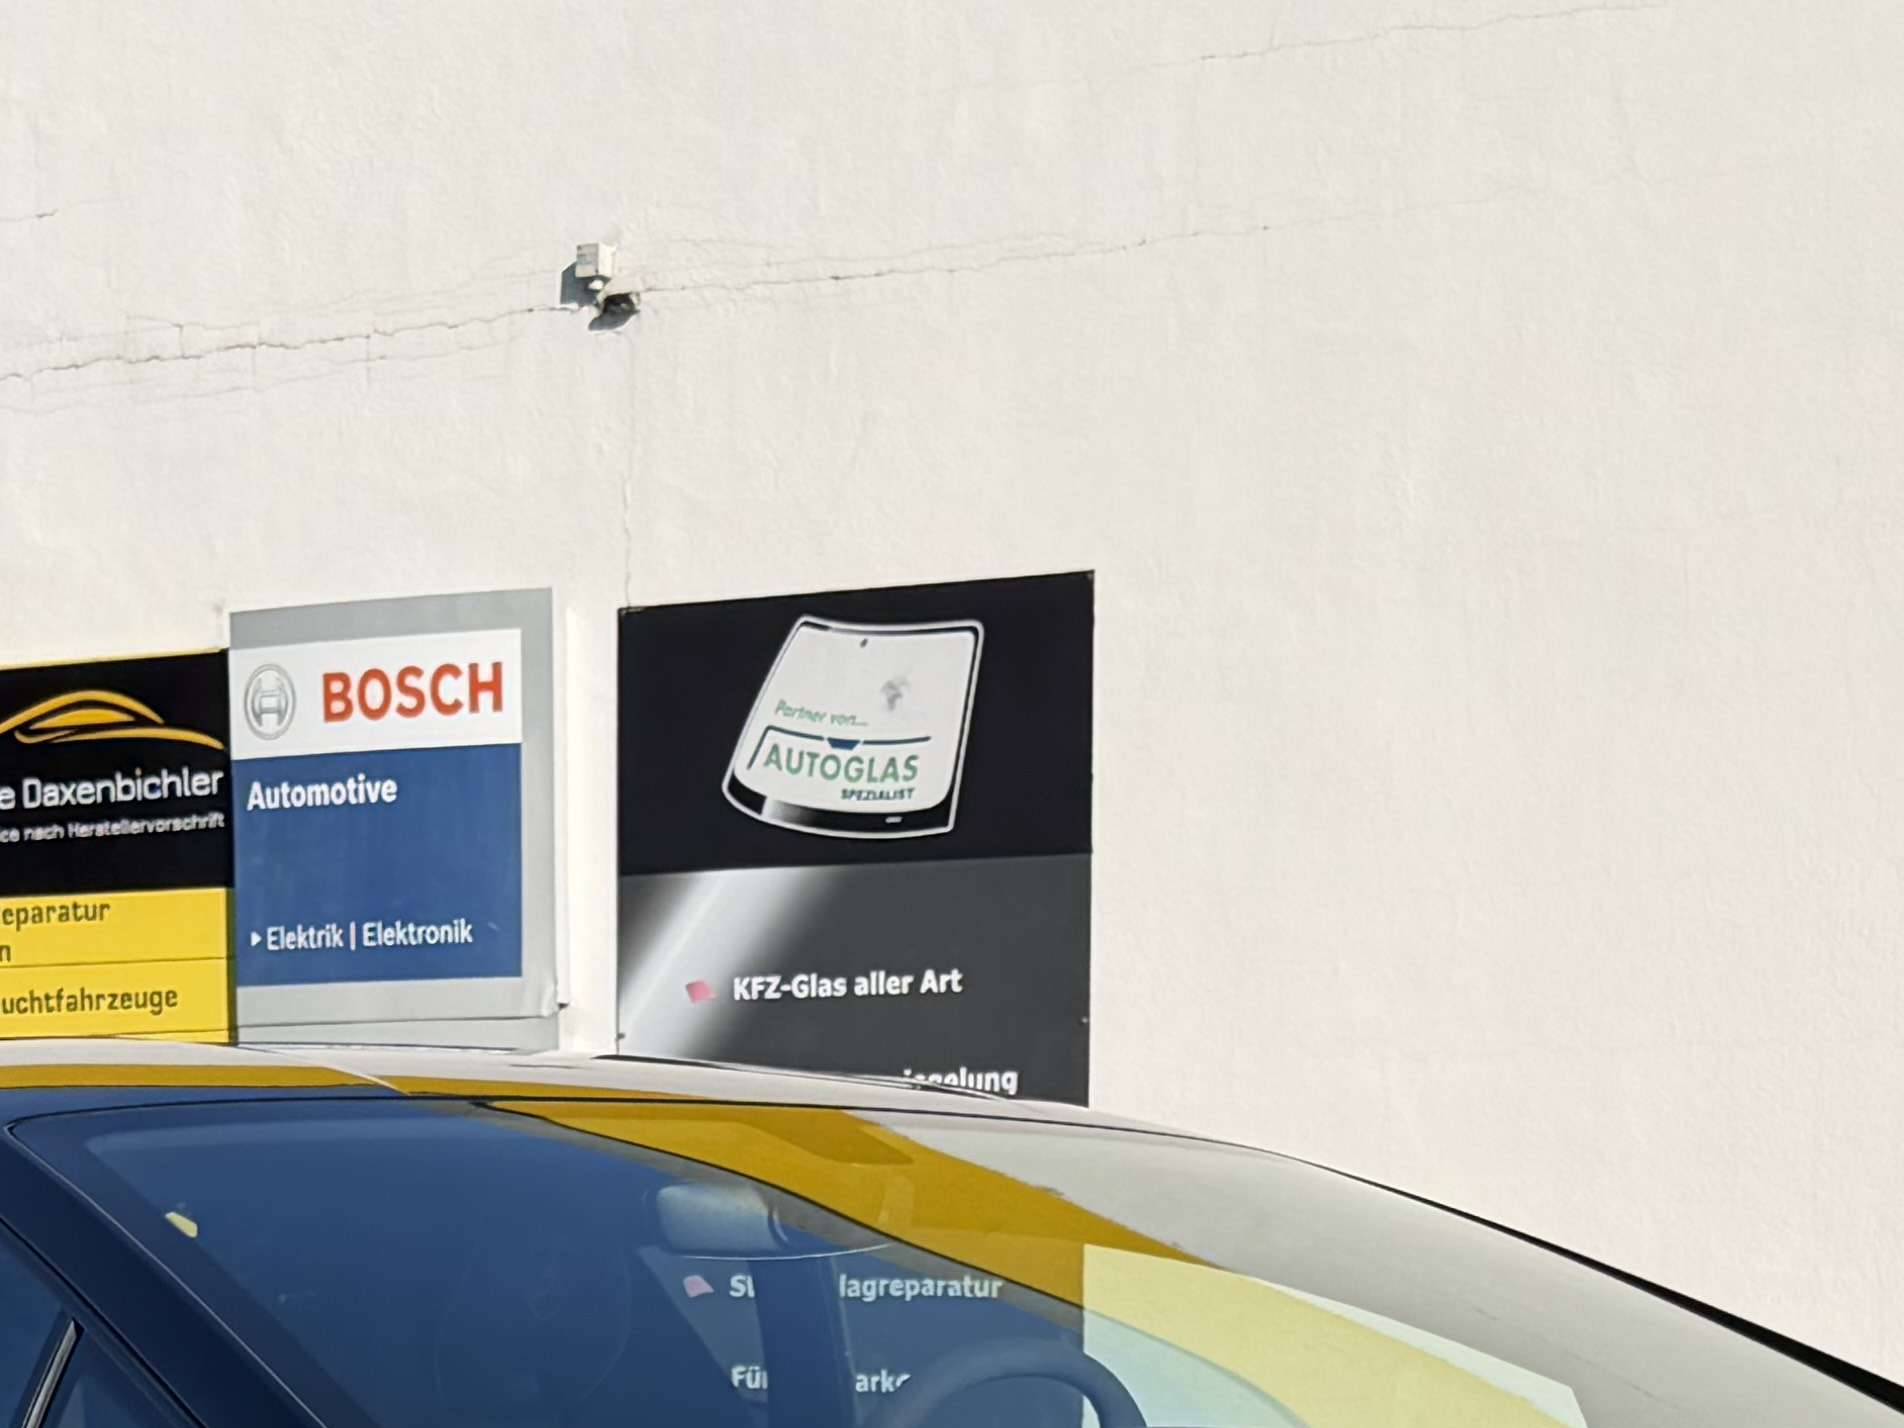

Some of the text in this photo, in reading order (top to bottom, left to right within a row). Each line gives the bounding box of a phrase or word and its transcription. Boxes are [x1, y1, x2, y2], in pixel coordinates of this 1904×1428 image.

[322, 662, 504, 723] BOSCH
[774, 699, 826, 723] Partner
[763, 743, 920, 784] AUTOGLAS
[22, 767, 224, 809] Daxenbichler
[246, 773, 398, 811] Automotive
[840, 787, 916, 801] SPEZIALIST
[23, 824, 64, 841] nach
[68, 811, 225, 838] Herstellervorschrift
[266, 923, 344, 951] Elektrik
[362, 918, 474, 947] Elektronik
[733, 968, 964, 1000] KFZ-Glas aller Art
